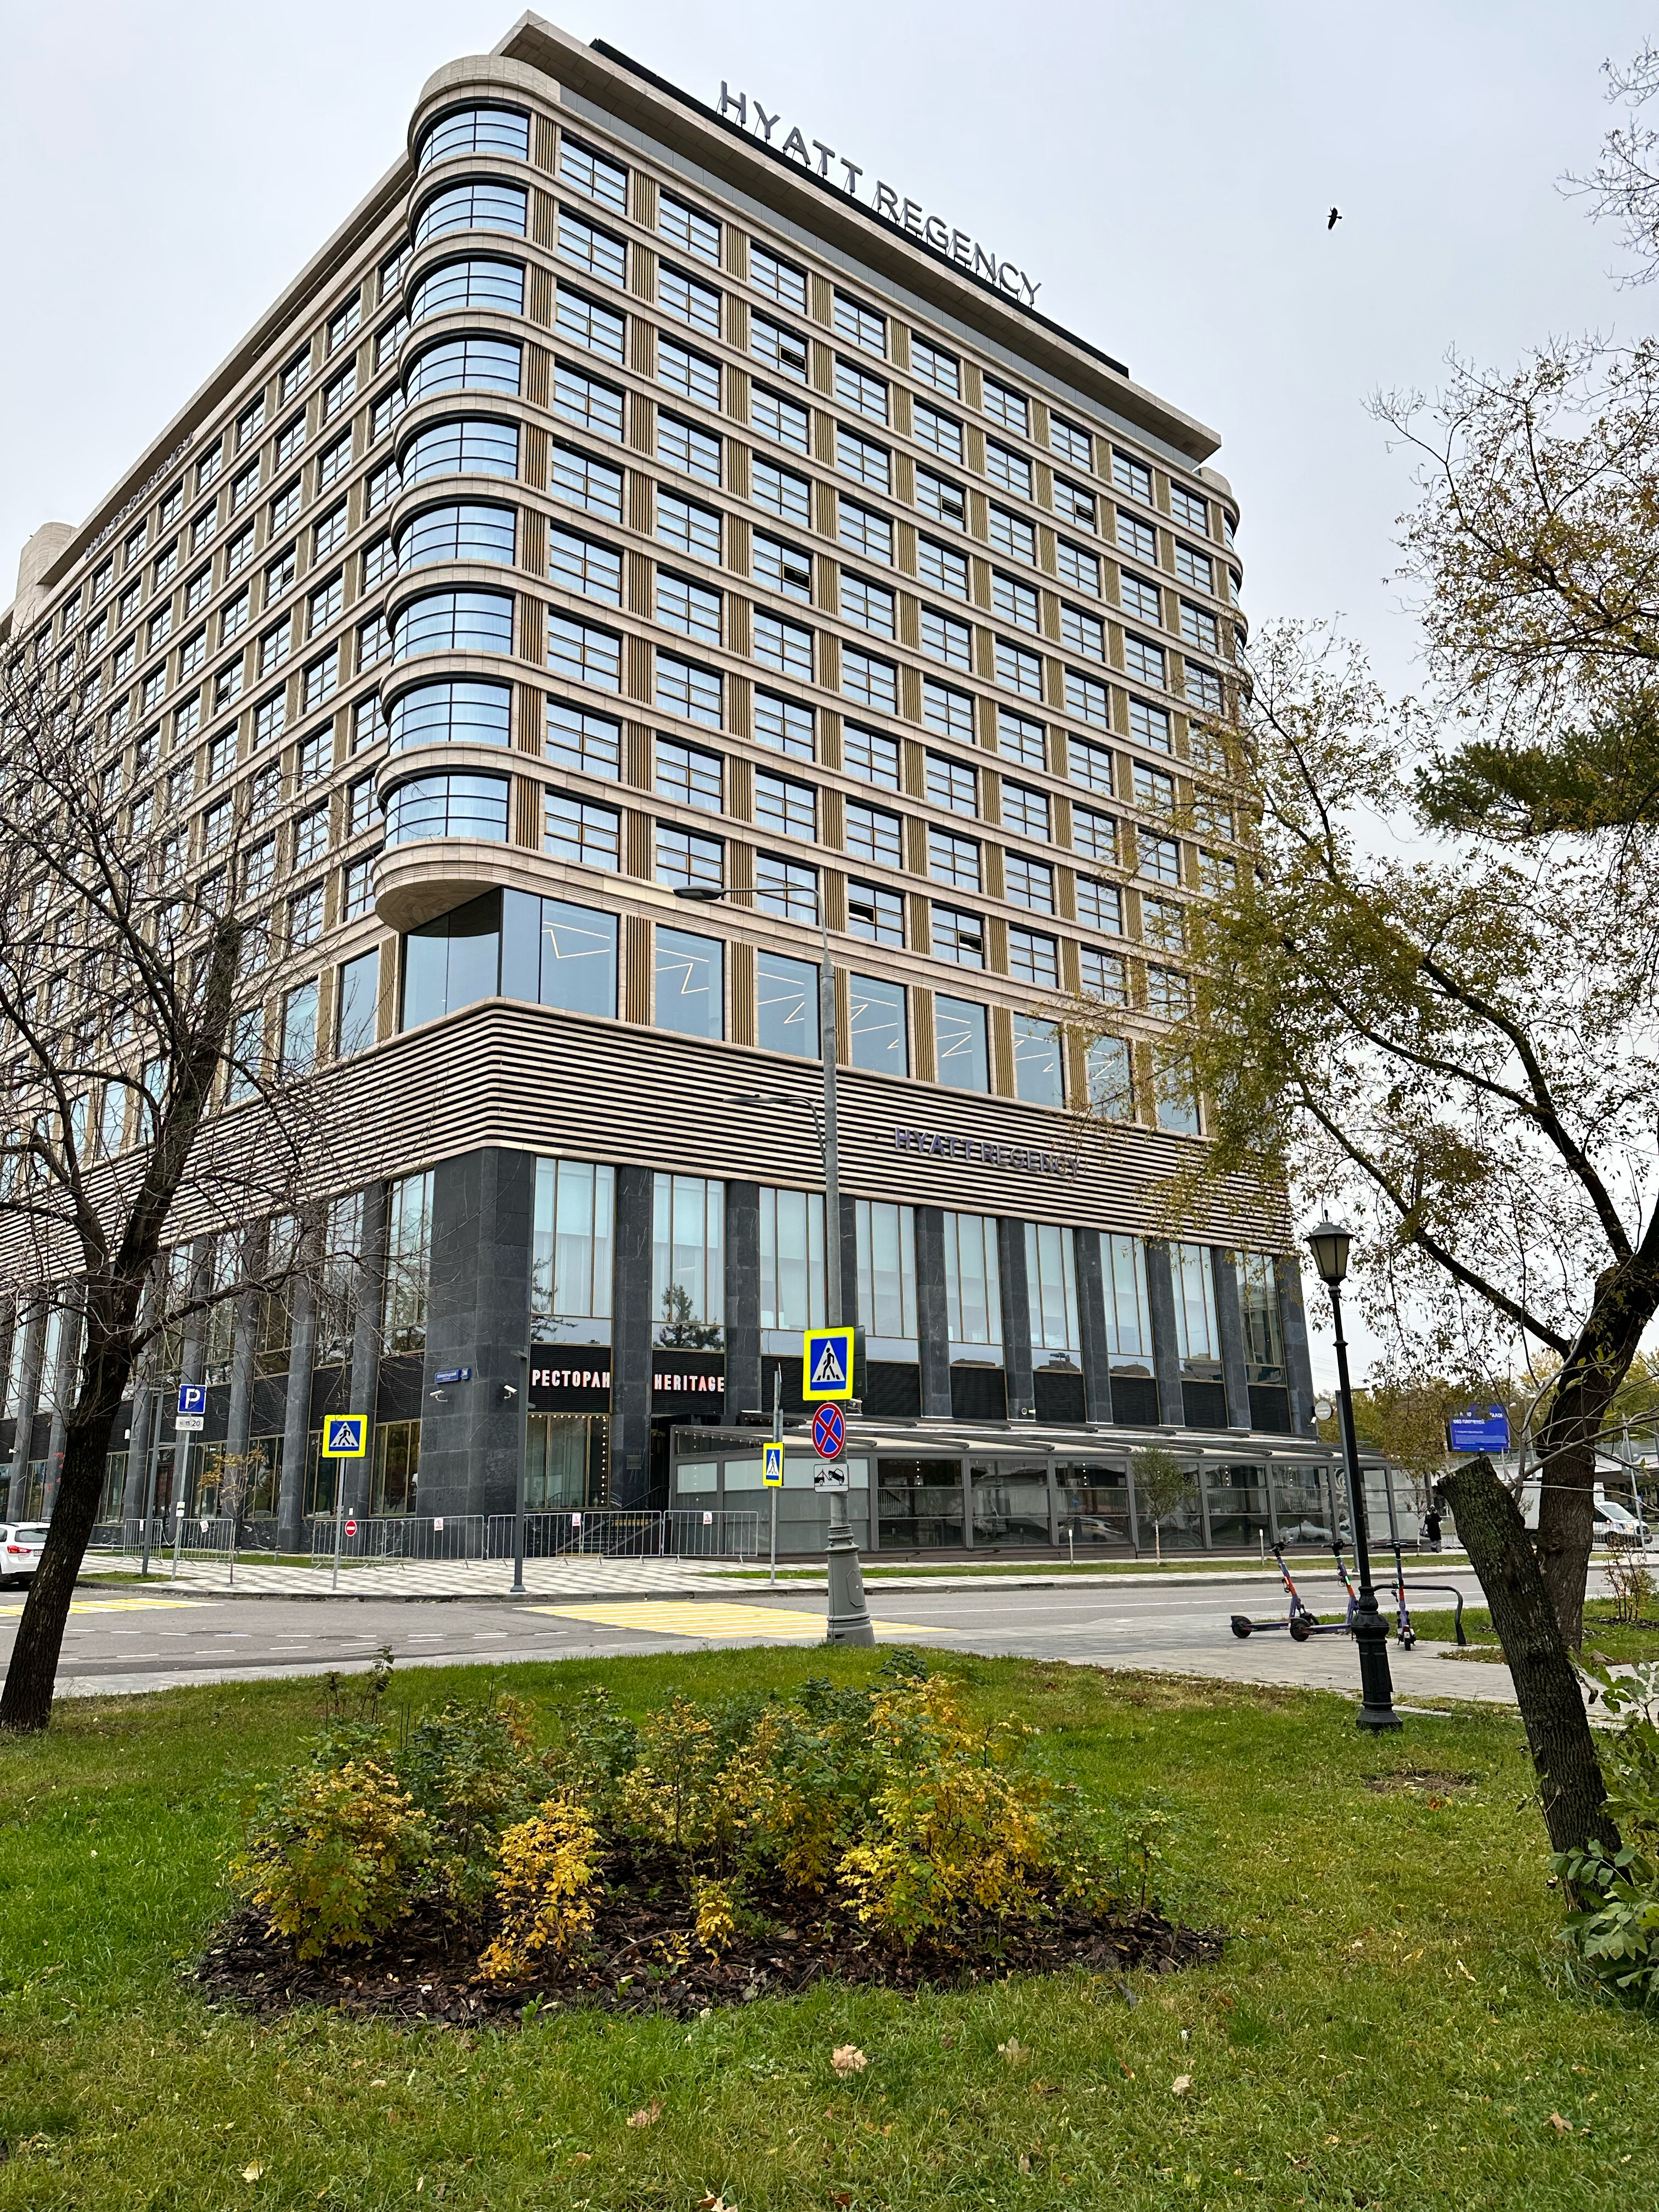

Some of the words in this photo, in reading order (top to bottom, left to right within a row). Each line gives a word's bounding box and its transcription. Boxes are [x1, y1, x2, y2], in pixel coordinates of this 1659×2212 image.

[720, 80, 863, 194] HYATT
[876, 179, 1042, 305] REGENCY
[895, 1127, 975, 1160] HYATT
[980, 1142, 1081, 1177] REGENCY
[532, 1369, 611, 1388] РЕСТОРАН
[654, 1374, 725, 1392] HERITAGE
[185, 1388, 201, 1409] P
